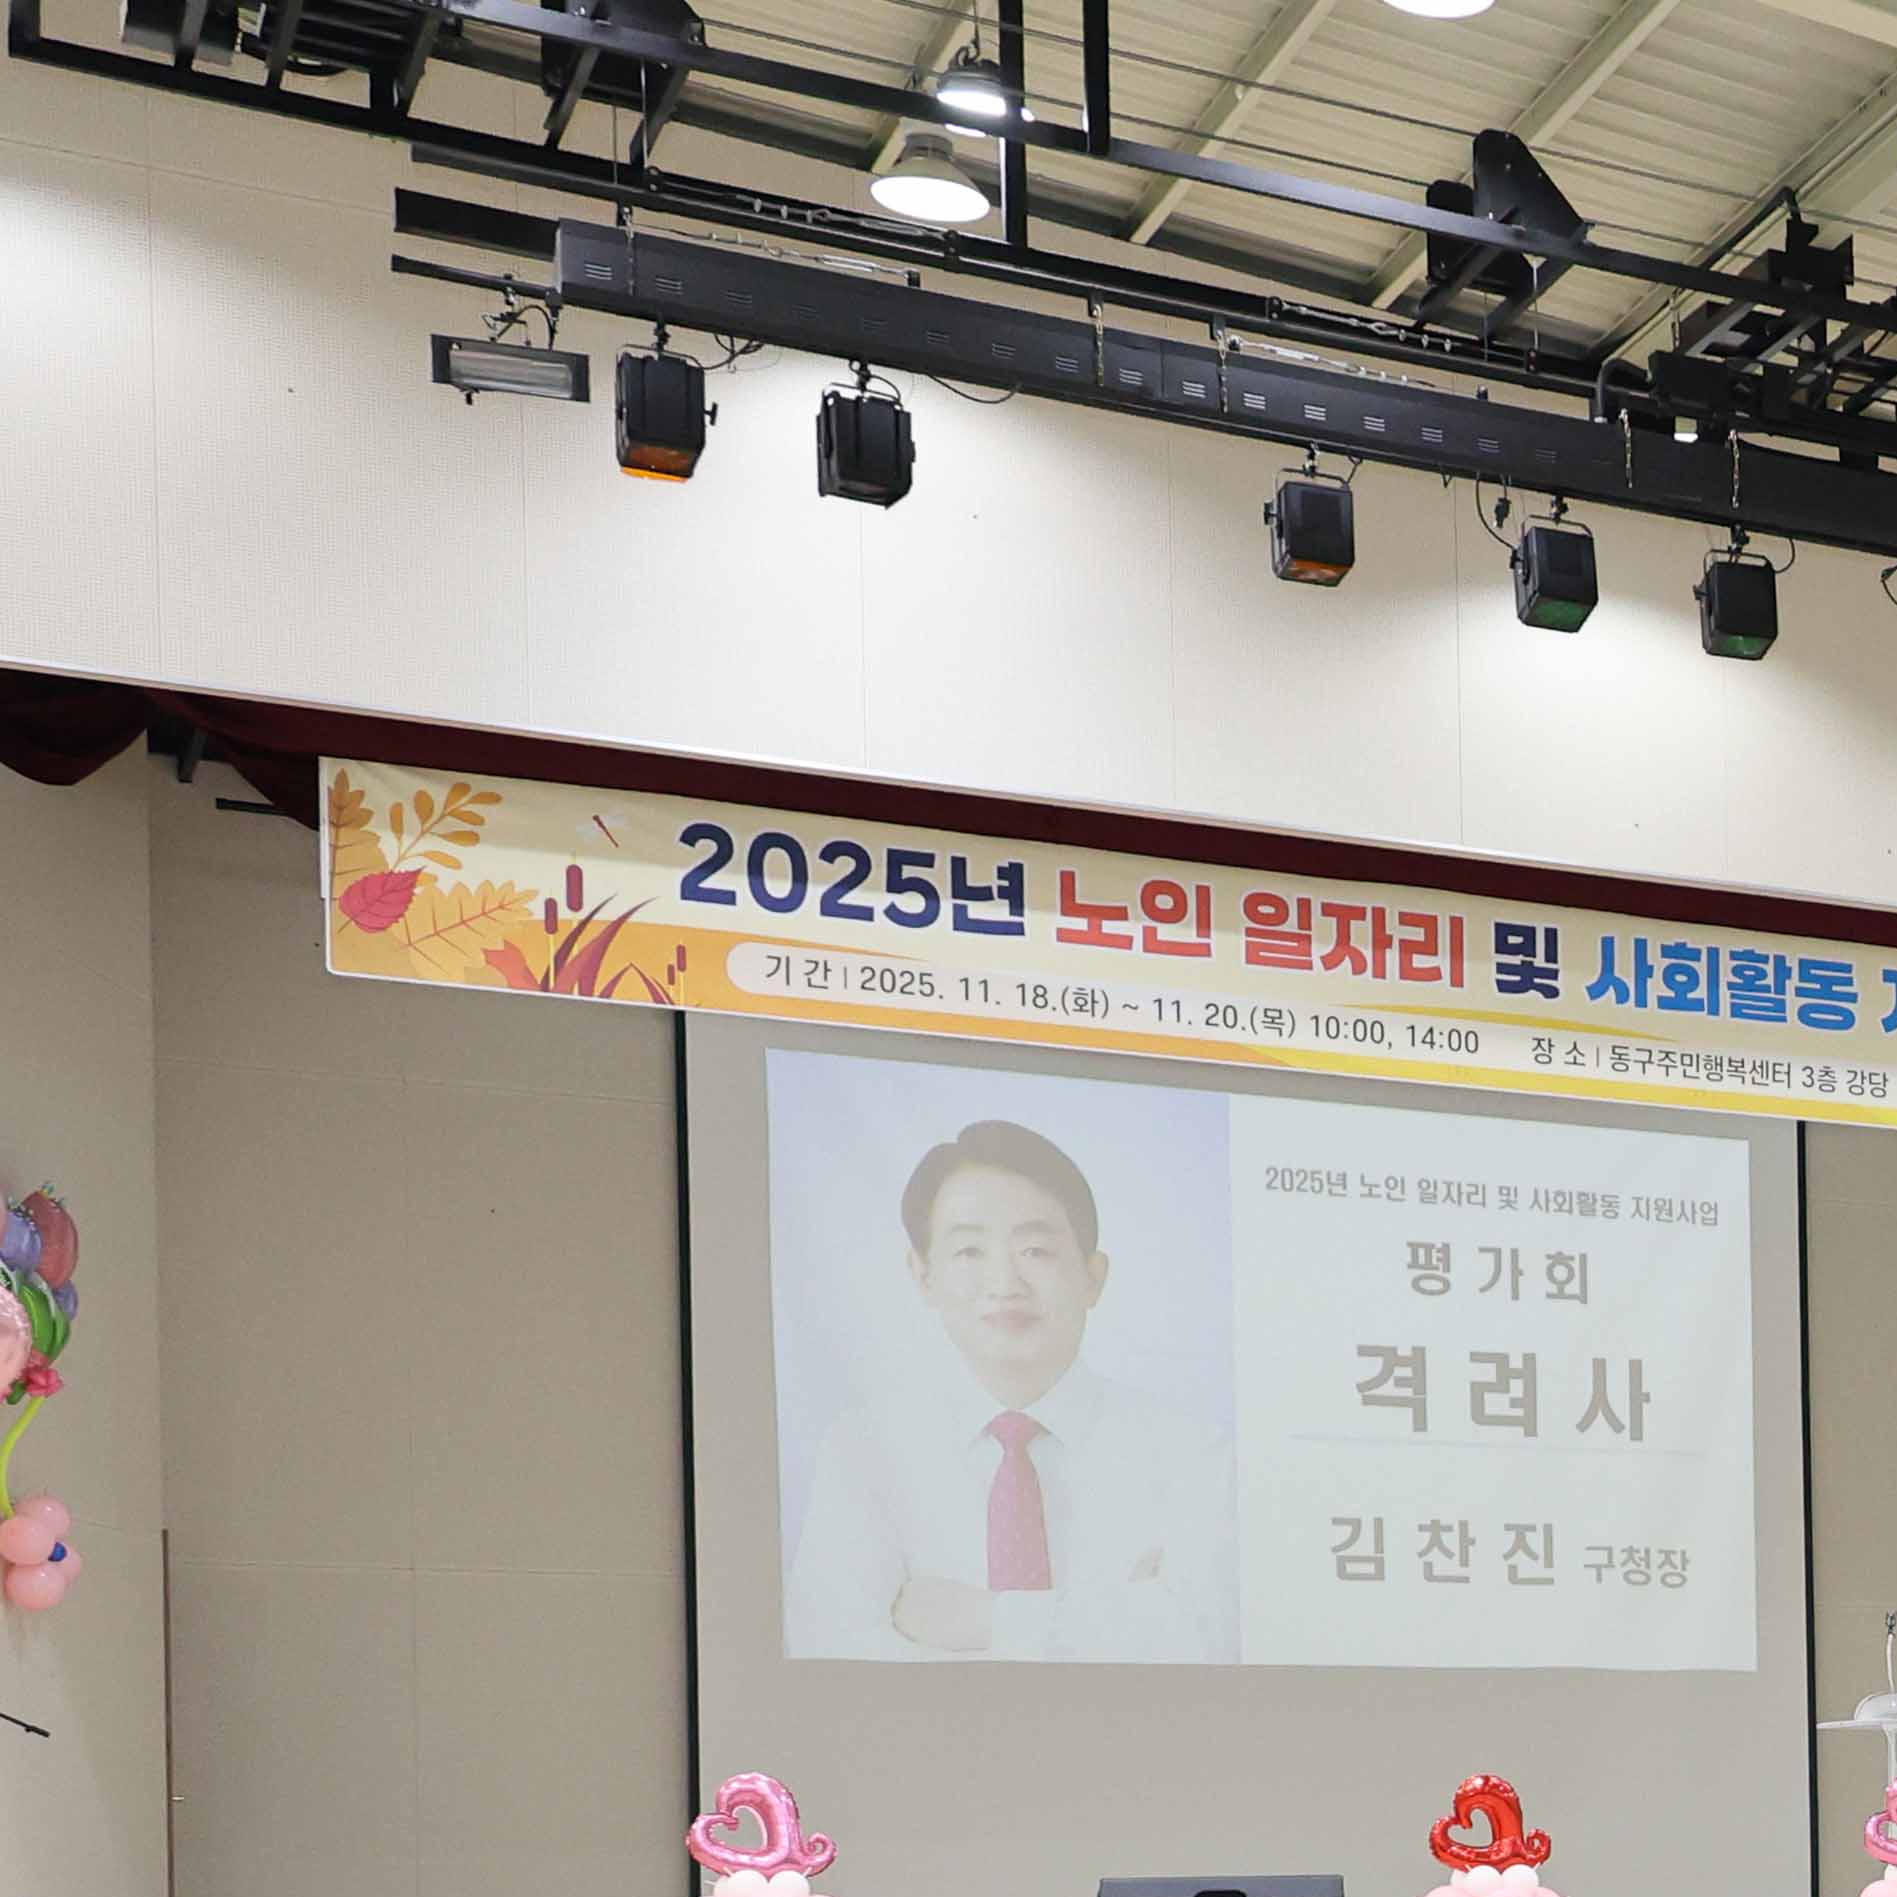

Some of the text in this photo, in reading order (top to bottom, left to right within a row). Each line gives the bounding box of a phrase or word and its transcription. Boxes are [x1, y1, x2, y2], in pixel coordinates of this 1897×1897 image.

[679, 822, 1025, 936] 2025년
[1056, 869, 1212, 958] 노인
[1243, 891, 1465, 988] 일자리
[1493, 921, 1561, 1000] 및
[1585, 935, 1859, 1031] 사회활동
[860, 966, 944, 1000] 2025.
[959, 977, 1001, 1005] 11.
[1016, 982, 1110, 1018] 18.(화)
[1152, 998, 1193, 1026] 11.
[1204, 1003, 1296, 1038] 20.(목)
[1309, 1014, 1393, 1050] 10:00,
[1405, 1025, 1479, 1053] 14:00
[1609, 1044, 1792, 1089] 동구주민행복센터
[1801, 1065, 1839, 1094] 3층
[1845, 1069, 1889, 1099] 강당
[1264, 1166, 1720, 1227] 2025년 노인 일자리 및 사회활동 지원사업
[1583, 1545, 1691, 1589] 구청장
